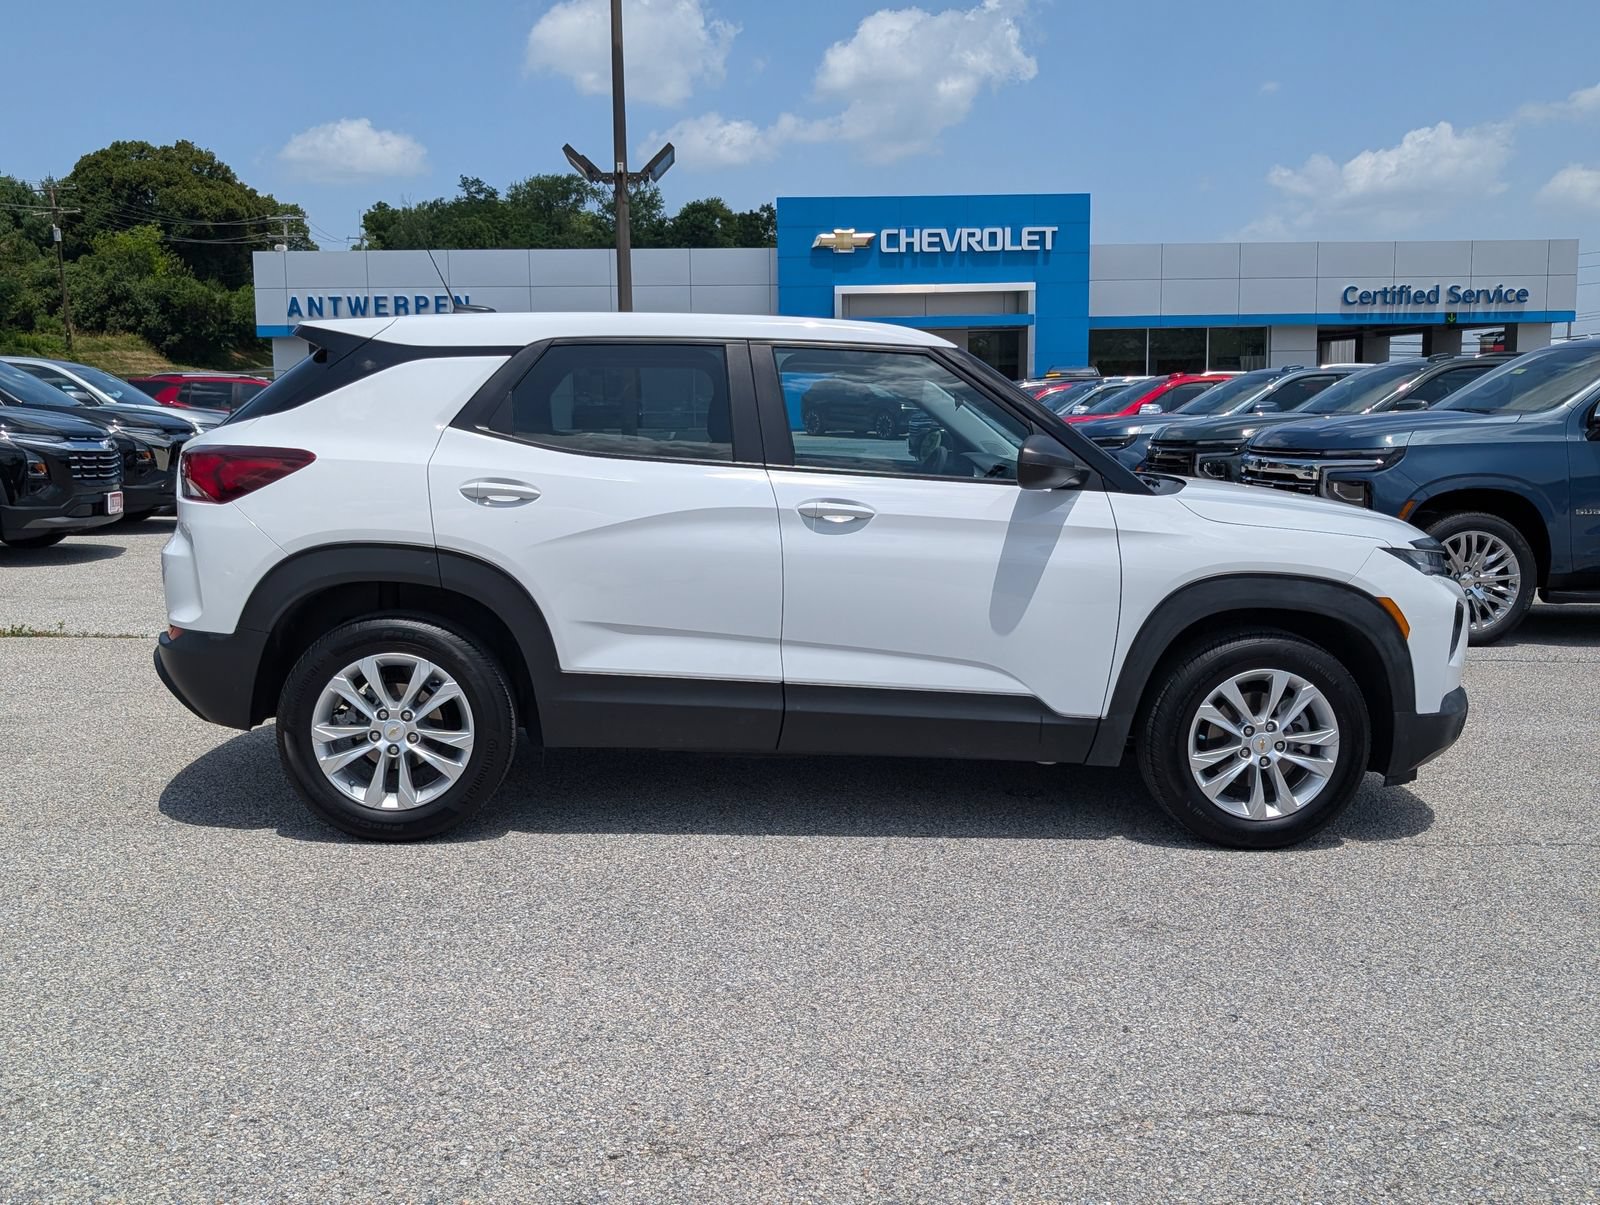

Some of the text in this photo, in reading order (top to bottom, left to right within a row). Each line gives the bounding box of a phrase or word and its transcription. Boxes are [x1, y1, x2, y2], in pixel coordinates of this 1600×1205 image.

[880, 226, 1058, 253] CHEVROLET
[1343, 284, 1530, 305] Certified Service
